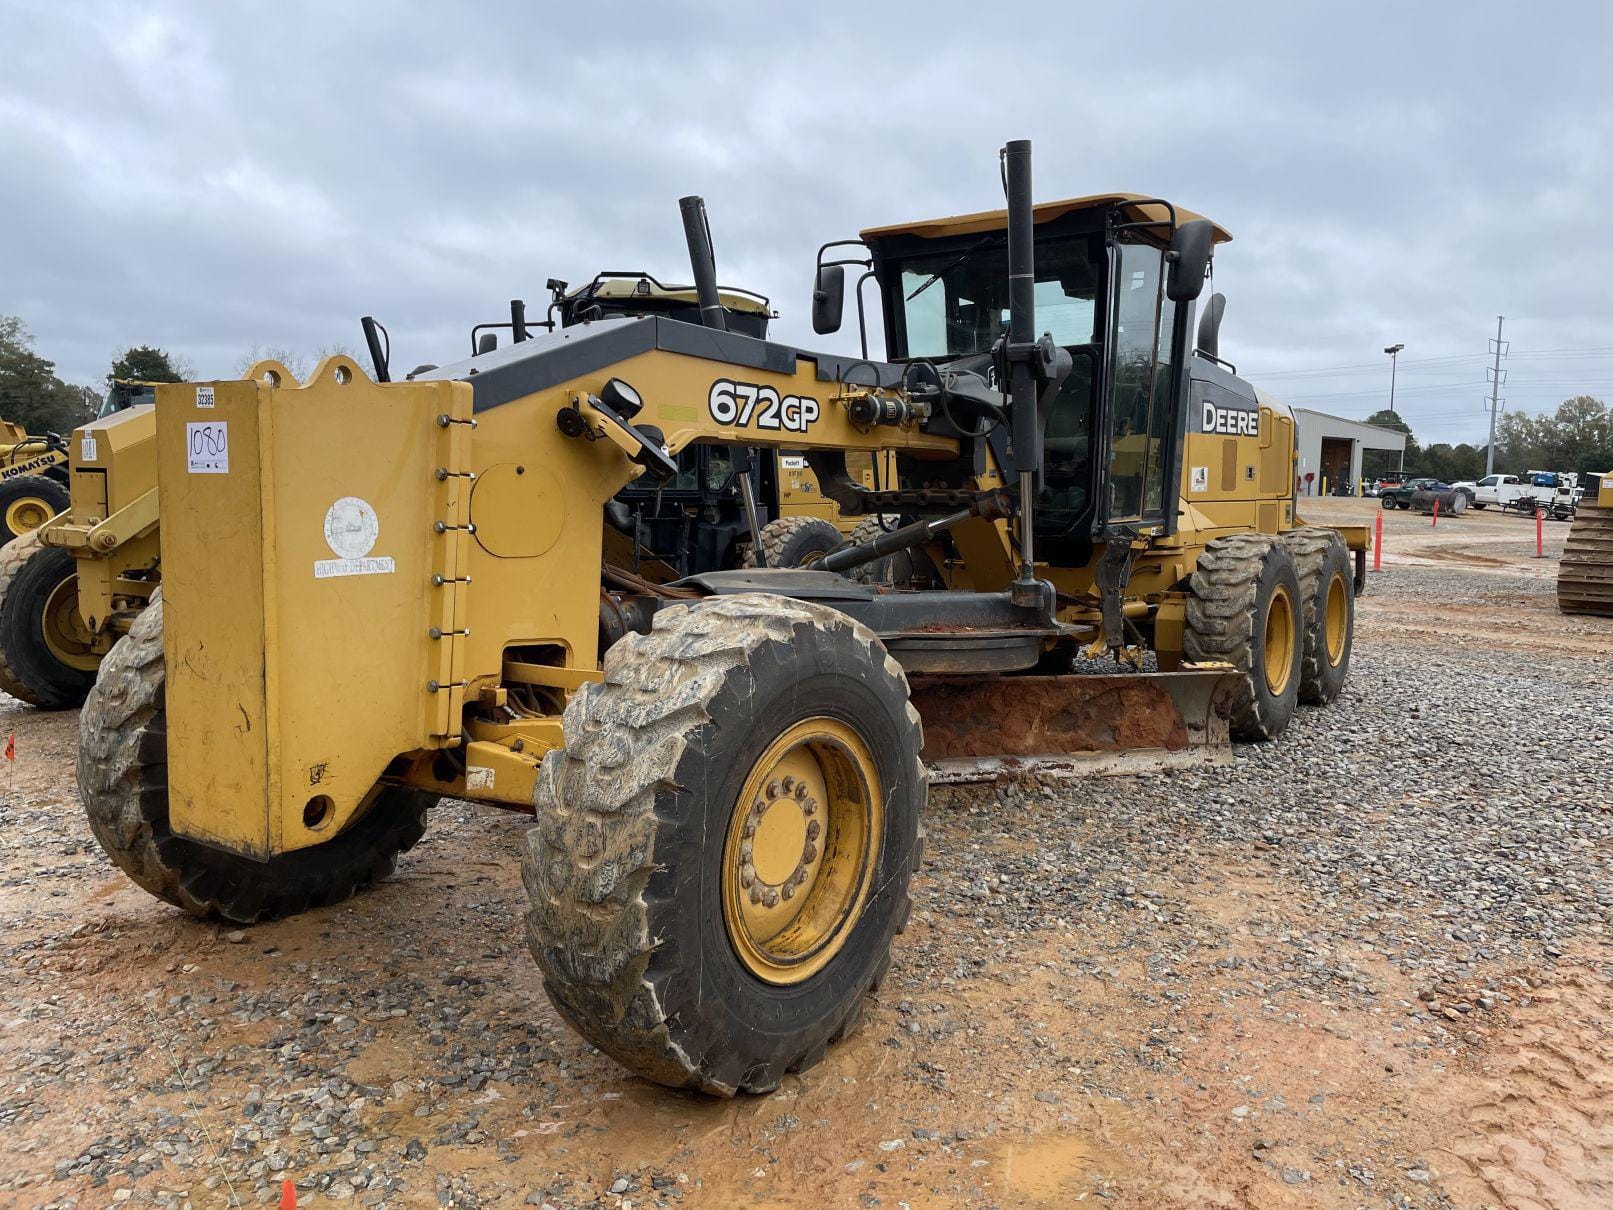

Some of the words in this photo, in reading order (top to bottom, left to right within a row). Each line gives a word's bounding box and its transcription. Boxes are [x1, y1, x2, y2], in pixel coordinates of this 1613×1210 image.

[708, 378, 820, 433] 672GP
[1202, 400, 1258, 436] DEERE
[190, 426, 226, 457] 1080
[1, 454, 56, 479] KOMATSU
[350, 559, 393, 573] DEPARTMENT
